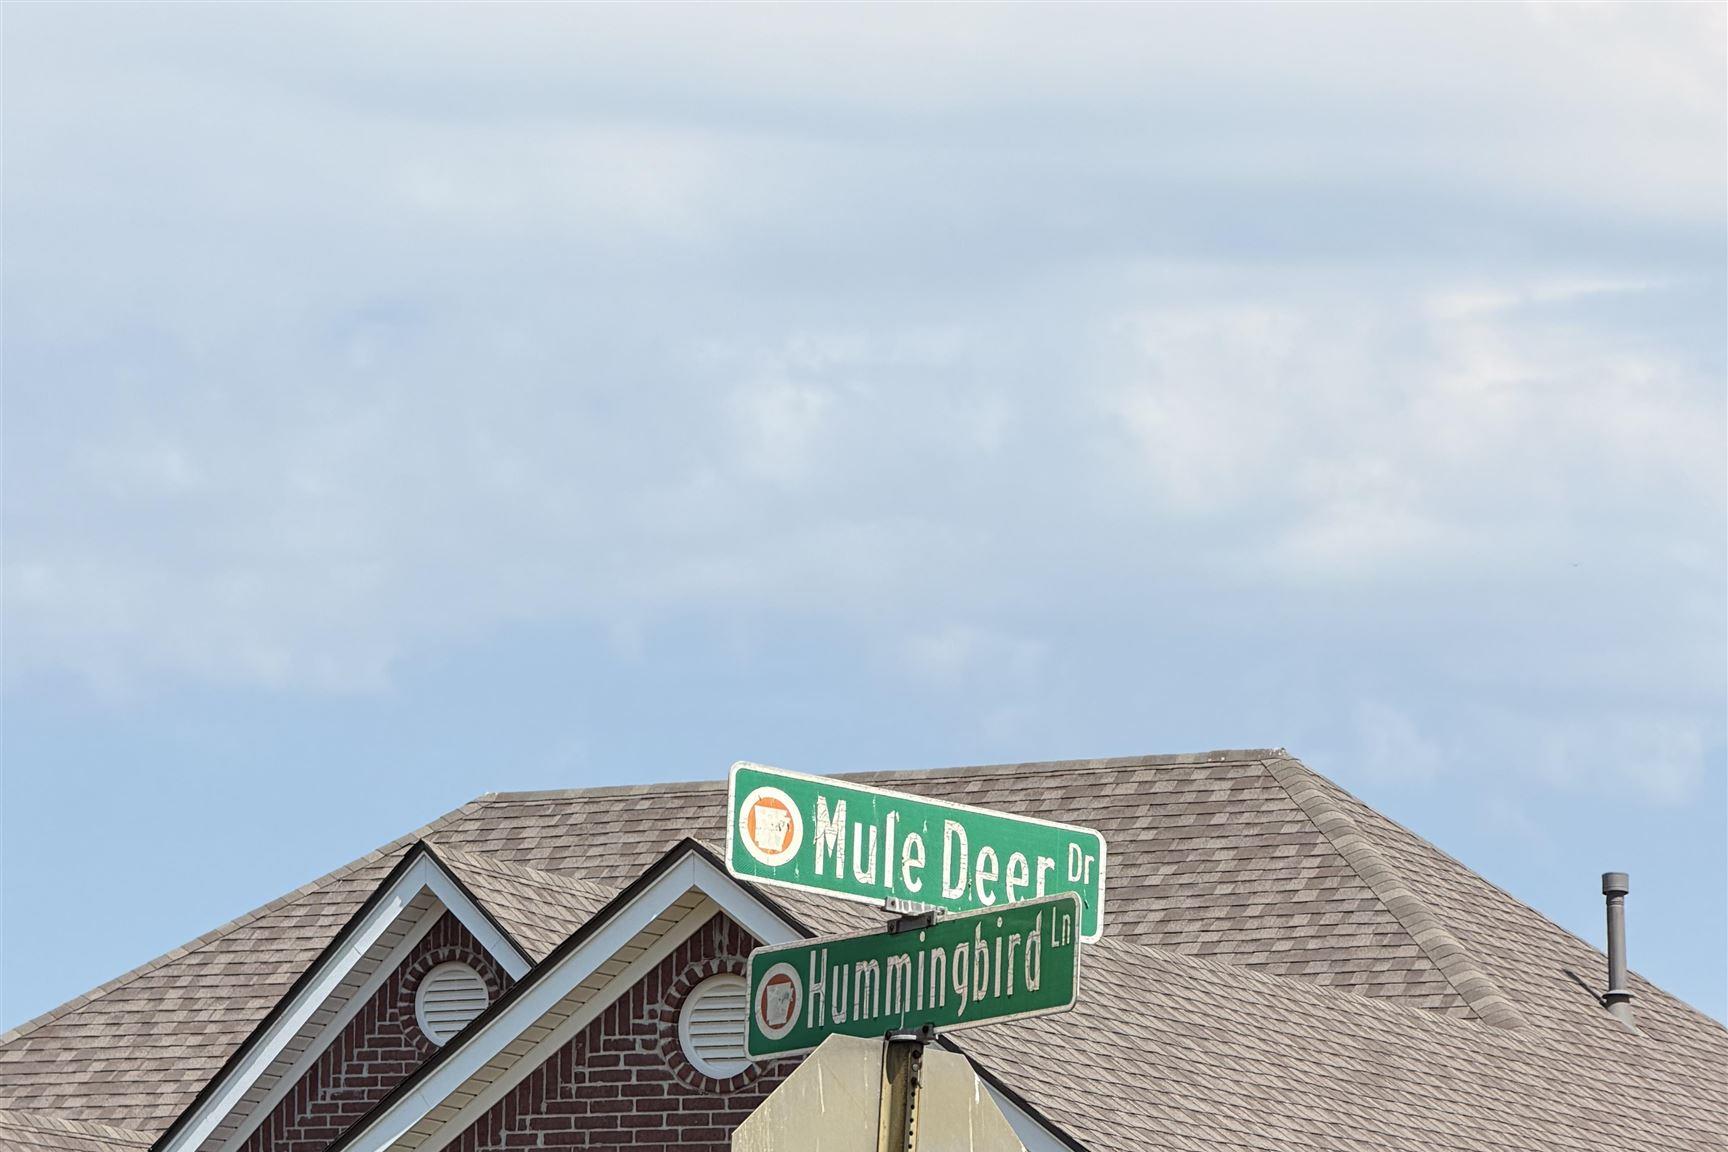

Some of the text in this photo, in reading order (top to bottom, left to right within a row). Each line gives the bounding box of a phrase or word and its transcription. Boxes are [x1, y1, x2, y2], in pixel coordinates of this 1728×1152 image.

[814, 796, 1095, 905] Mule Deer Dr
[808, 907, 1070, 1028] Hummingbird Ln
